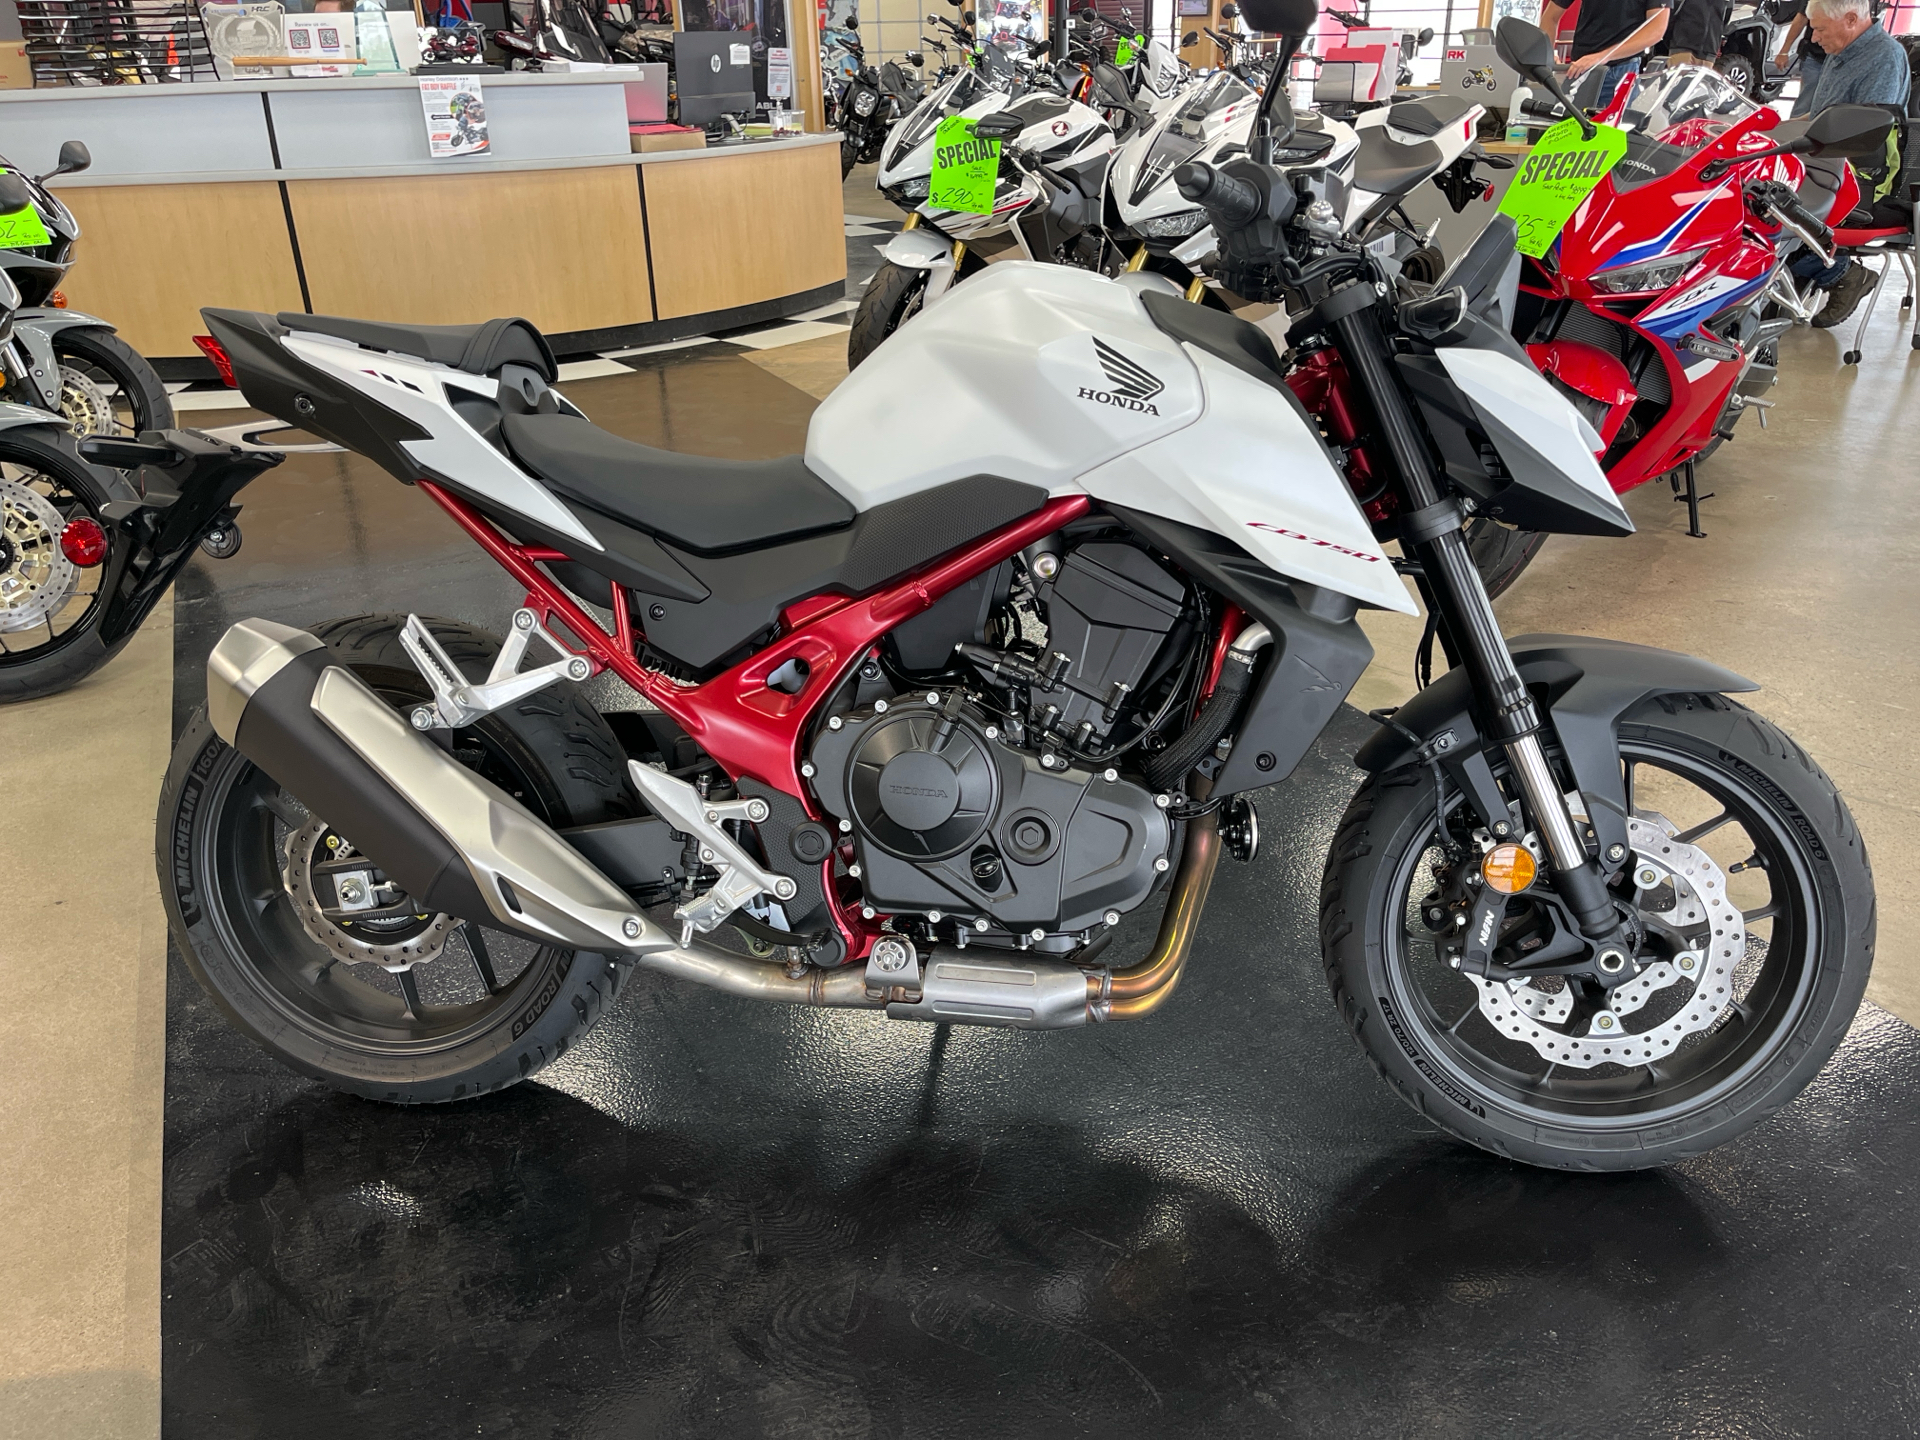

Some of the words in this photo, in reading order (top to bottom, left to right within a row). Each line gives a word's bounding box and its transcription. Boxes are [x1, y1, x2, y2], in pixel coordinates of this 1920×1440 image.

[1447, 50, 1465, 59] RK
[440, 82, 457, 90] RAFFLE
[936, 138, 997, 170] SPECIAL
[1520, 150, 1610, 186] SPECIAL
[1666, 281, 1719, 310] CBR
[1077, 387, 1160, 417] HONDA
[1245, 522, 1380, 562] CB750
[889, 785, 949, 798] HONDA
[1739, 764, 1792, 809] MICHELIN
[1794, 818, 1820, 849] ROAD
[1814, 849, 1826, 860] 6
[175, 785, 199, 888] MICHELIN
[525, 979, 558, 1025] ROAD
[1382, 1002, 1390, 1013] 17
[513, 1021, 524, 1036] 6
[1394, 1027, 1415, 1056] 120/70
[1418, 1061, 1469, 1106] MICHELIN
